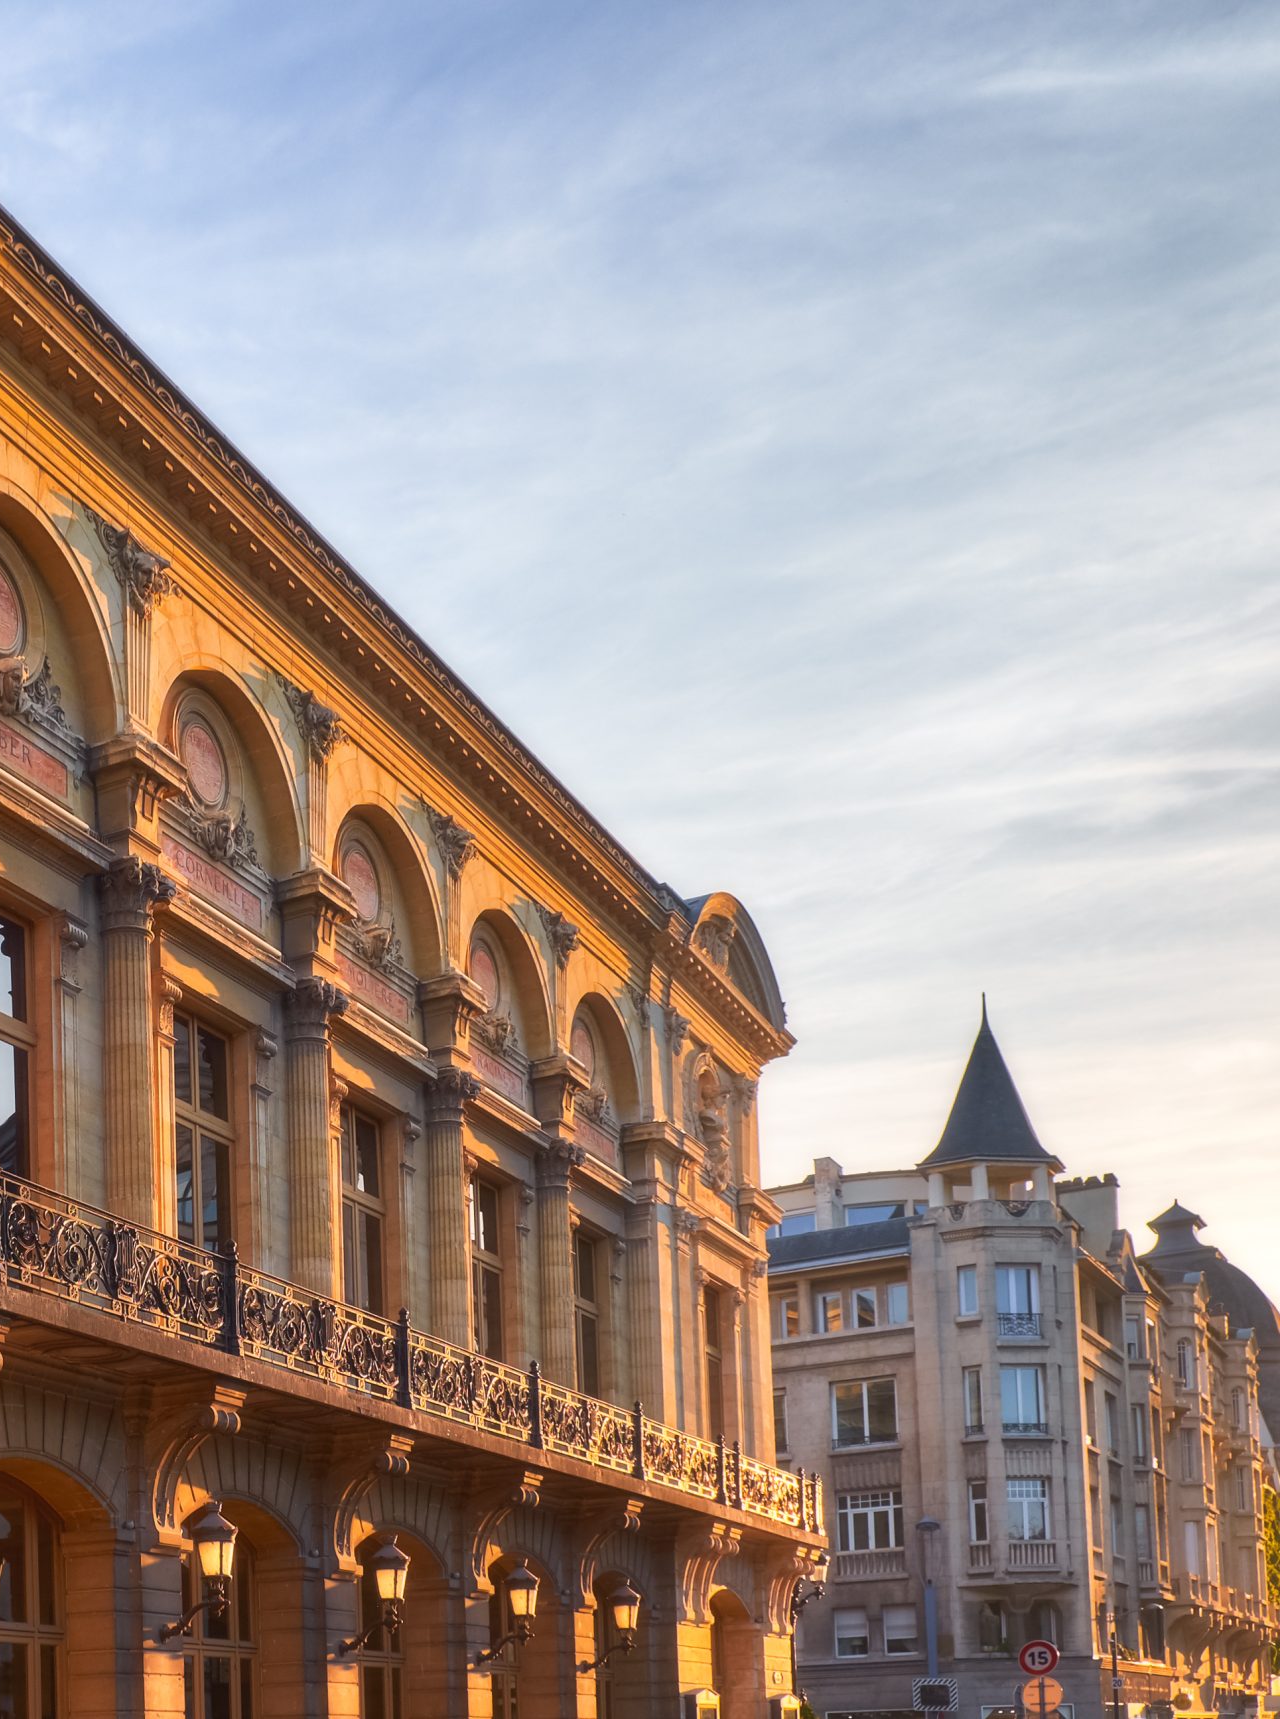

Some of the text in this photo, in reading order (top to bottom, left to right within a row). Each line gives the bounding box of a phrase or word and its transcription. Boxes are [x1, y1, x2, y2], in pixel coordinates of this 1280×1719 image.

[175, 849, 247, 911] CORNEILLE
[347, 964, 395, 1009] MOLIERE
[1027, 1650, 1049, 1667] 15
[1112, 1679, 1123, 1688] 20
